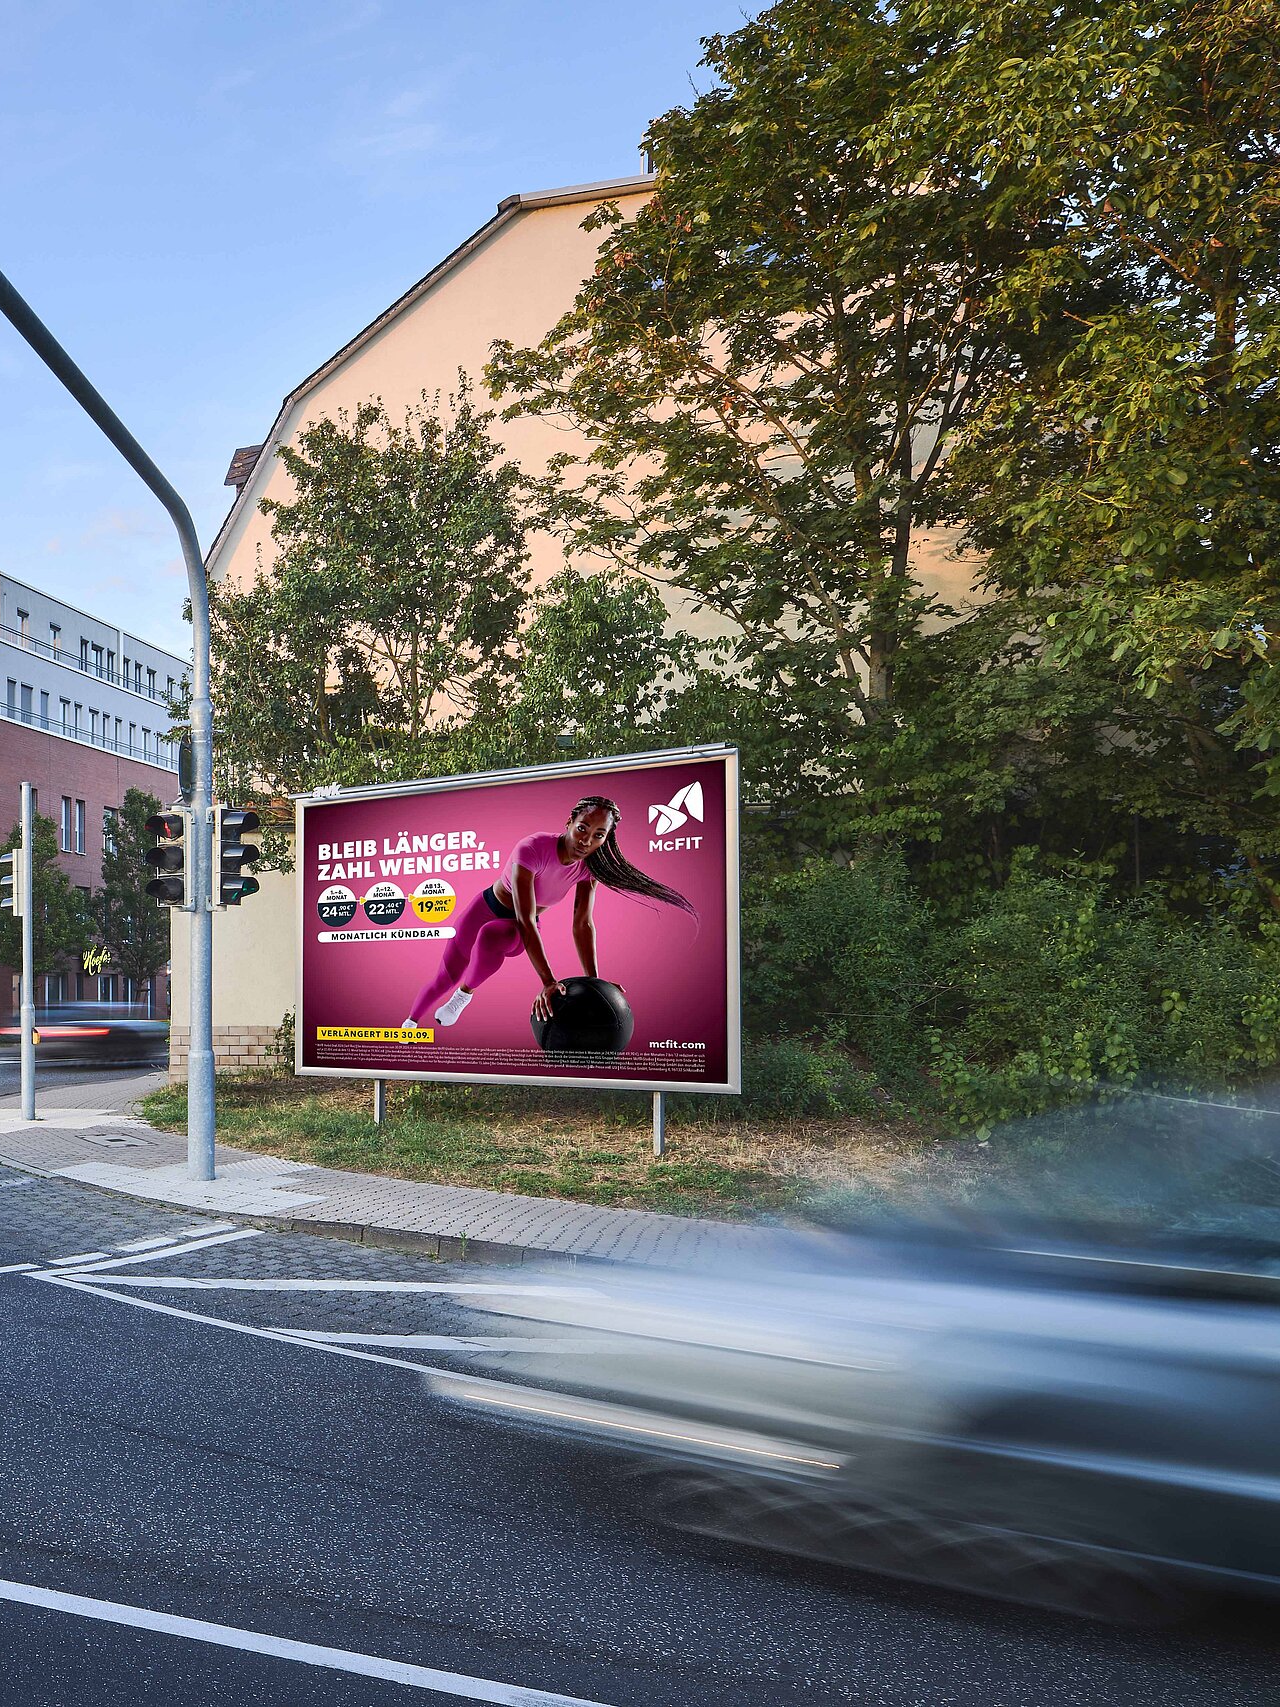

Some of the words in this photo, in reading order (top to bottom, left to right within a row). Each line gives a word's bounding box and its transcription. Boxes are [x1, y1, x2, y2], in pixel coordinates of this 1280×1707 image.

[318, 839, 377, 861] BLEIB
[383, 831, 485, 856] LÄNGER,
[648, 836, 703, 853] McFIT
[317, 861, 375, 881] ZAHL
[379, 850, 500, 877] WENIGER!
[331, 930, 387, 941] MONATLICH
[390, 929, 440, 939] KÜNDBAR
[321, 1028, 381, 1038] VERLÄNGERT
[384, 1030, 399, 1039] BIS
[401, 1031, 430, 1039] 30.09.
[649, 1039, 706, 1050] mcfit.com
